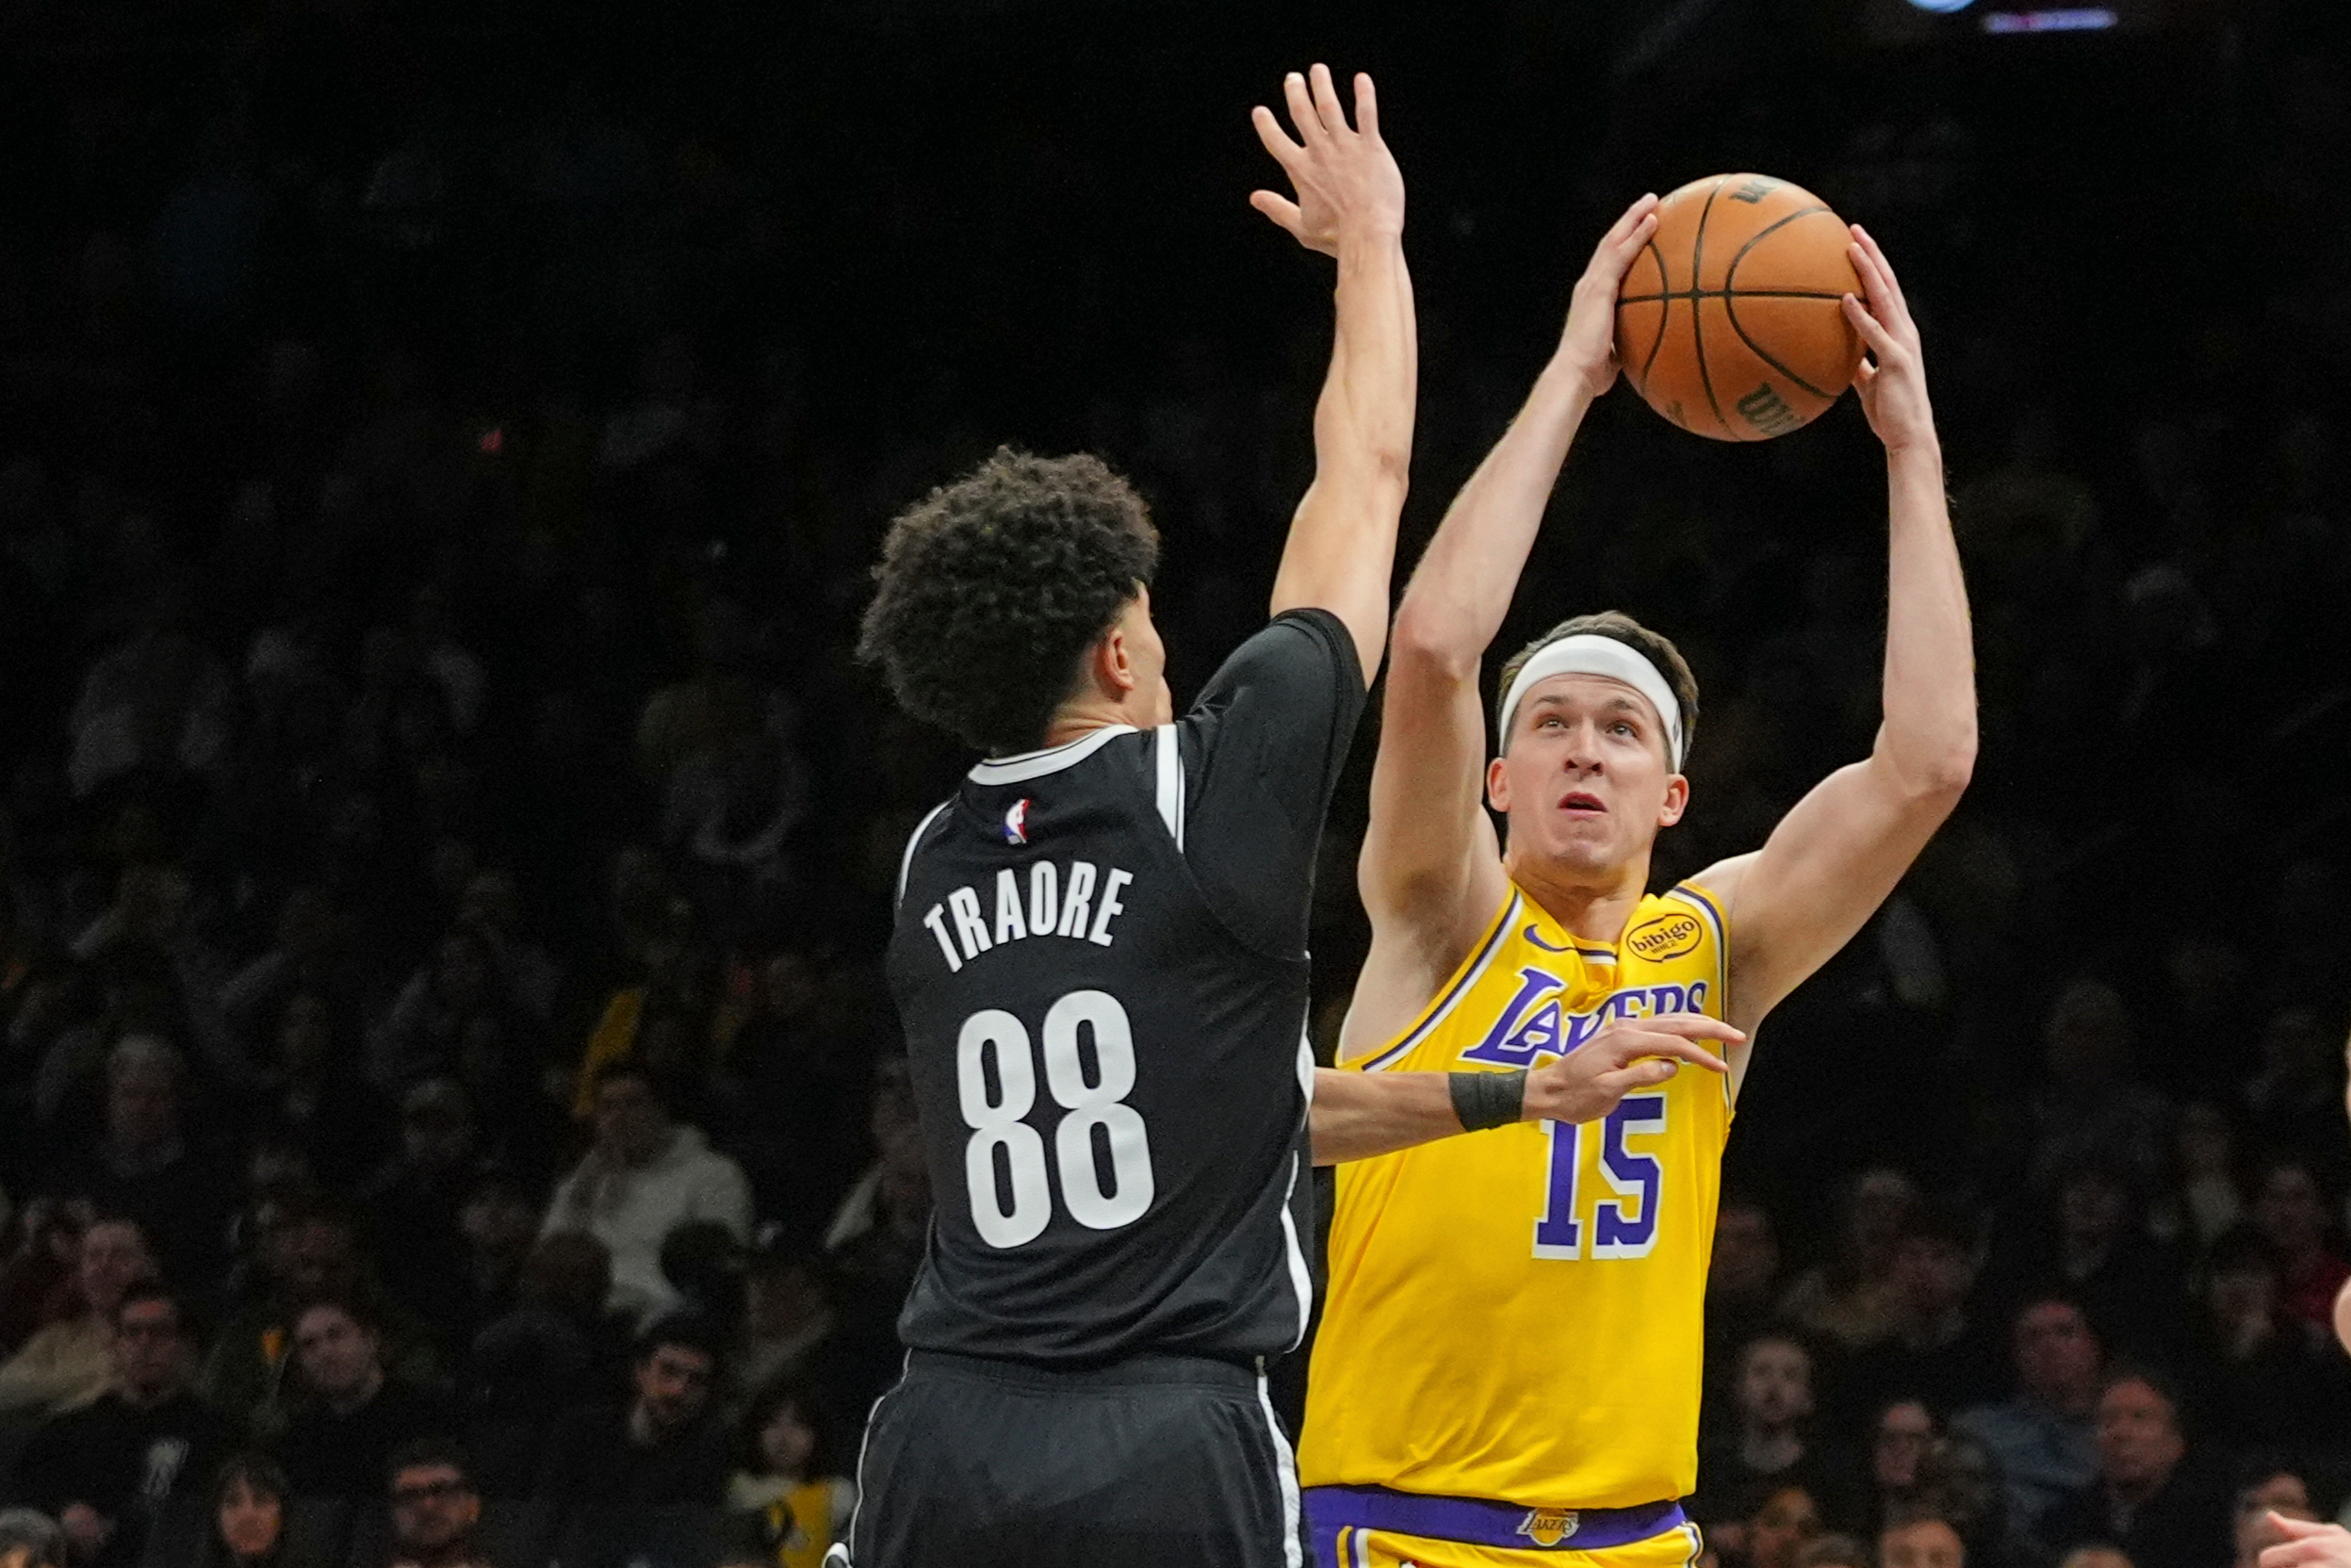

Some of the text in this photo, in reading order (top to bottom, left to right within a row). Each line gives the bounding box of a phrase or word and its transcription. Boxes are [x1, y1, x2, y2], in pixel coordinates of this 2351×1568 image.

[922, 859, 1134, 972] TRAORE
[1631, 921, 1695, 952] bibigo
[957, 989, 1155, 1249] 88
[1531, 1091, 1668, 1262] 15
